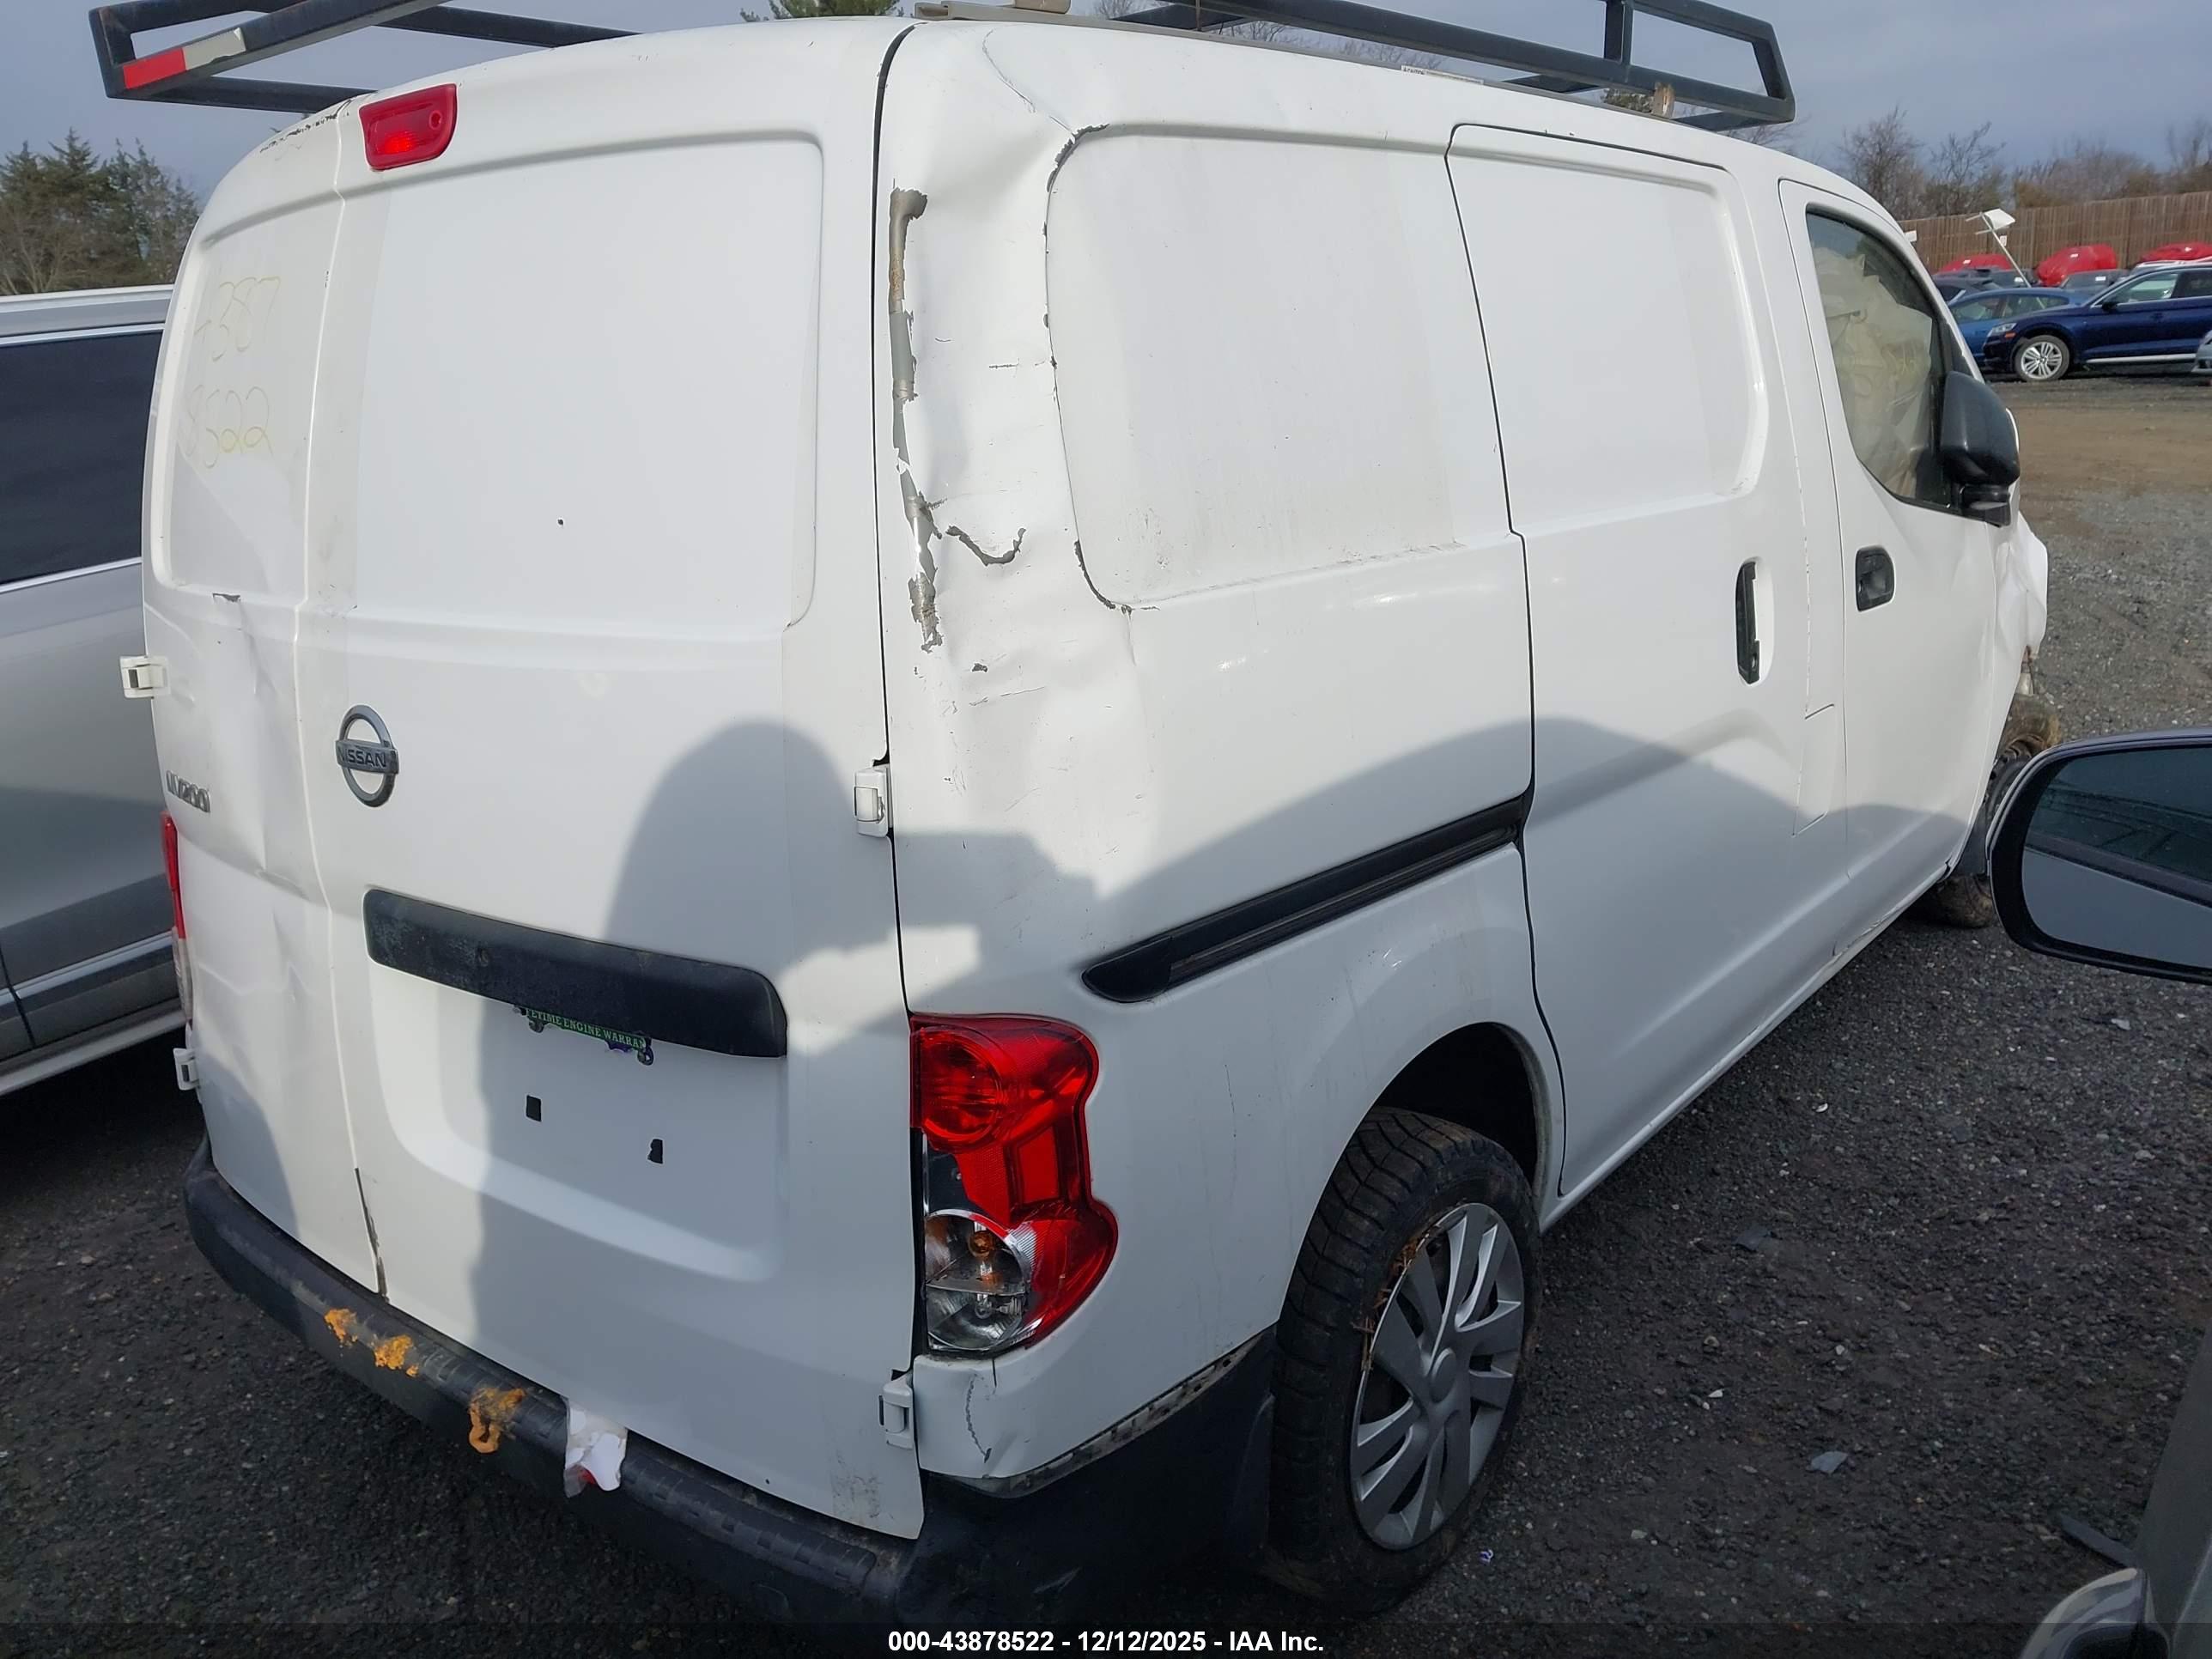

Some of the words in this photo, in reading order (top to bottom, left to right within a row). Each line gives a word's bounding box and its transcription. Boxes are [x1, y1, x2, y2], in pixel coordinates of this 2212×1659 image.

[337, 746, 387, 769] NISSAN
[166, 769, 211, 814] NV200
[526, 1007, 562, 1025] FETIME
[563, 1017, 602, 1037] ENGINE
